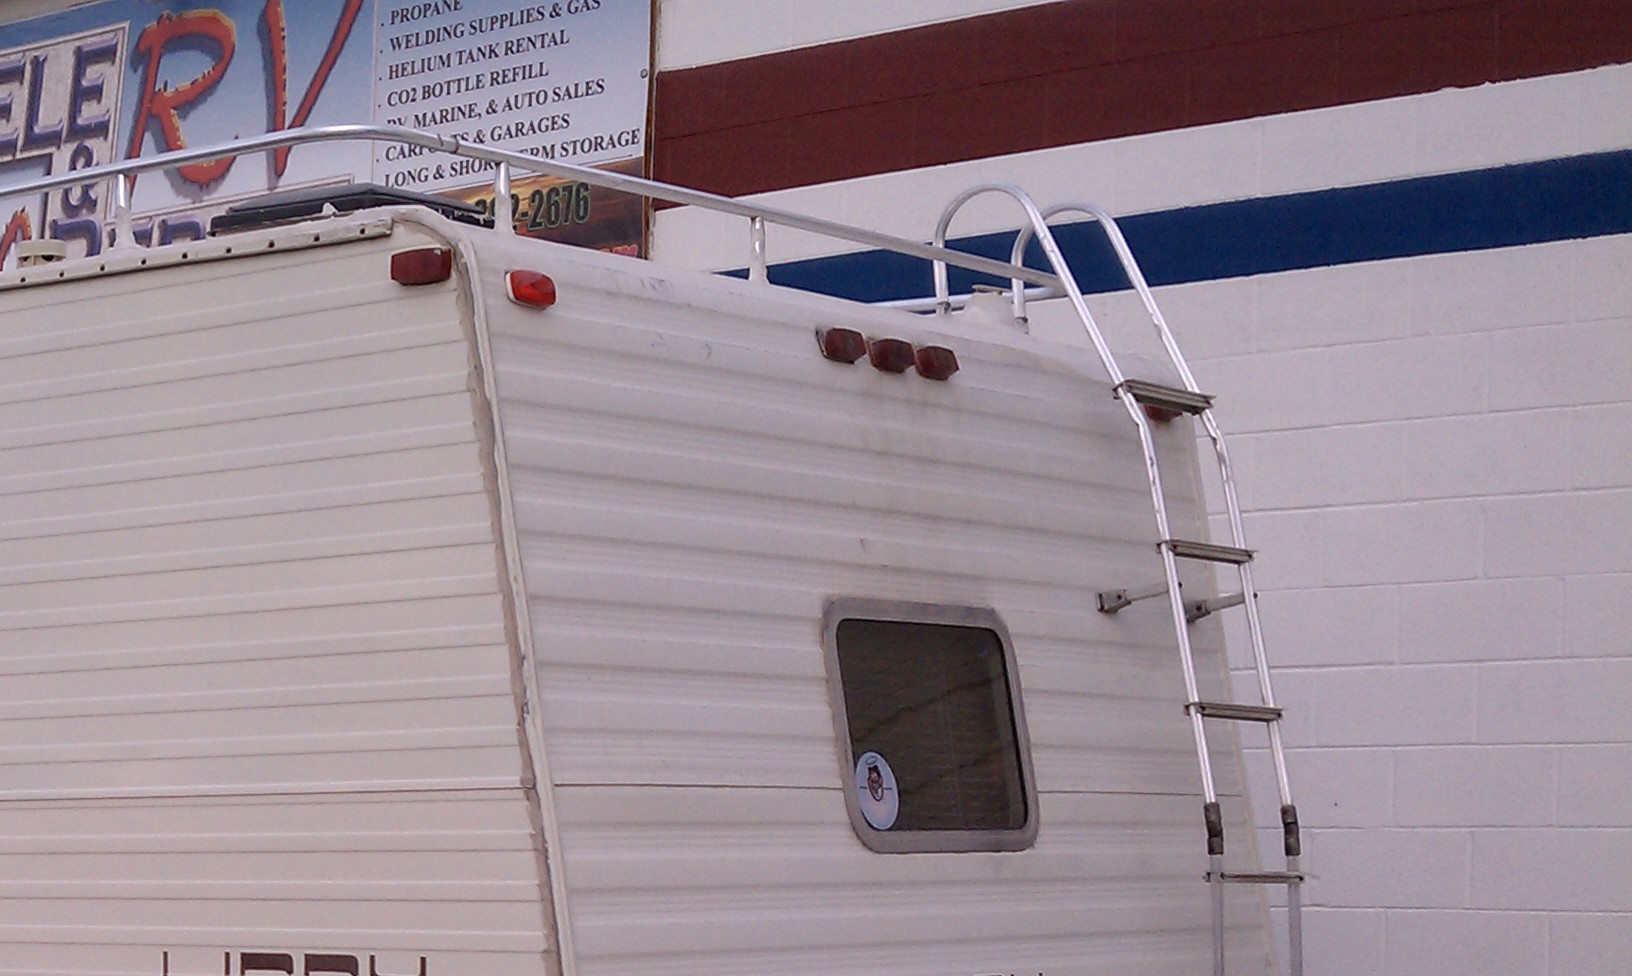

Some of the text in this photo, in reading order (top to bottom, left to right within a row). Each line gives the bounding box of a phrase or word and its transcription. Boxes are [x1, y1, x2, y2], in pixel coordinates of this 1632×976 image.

[389, 0, 463, 26] PROPANE
[389, 0, 601, 52] WELDING SUPPLIES & GAS
[388, 29, 570, 81] HELIUM TANK RENTAL
[120, 0, 366, 198] RV
[386, 61, 550, 107] CO2 BOTTLE REFILL
[413, 102, 483, 129] MARINE,
[485, 98, 499, 115] &
[501, 88, 548, 113] AUTO
[551, 78, 605, 103] SALES
[384, 112, 571, 162] CARPS & GARAGES
[384, 128, 641, 188] LONG & SHOR RM STORAGE
